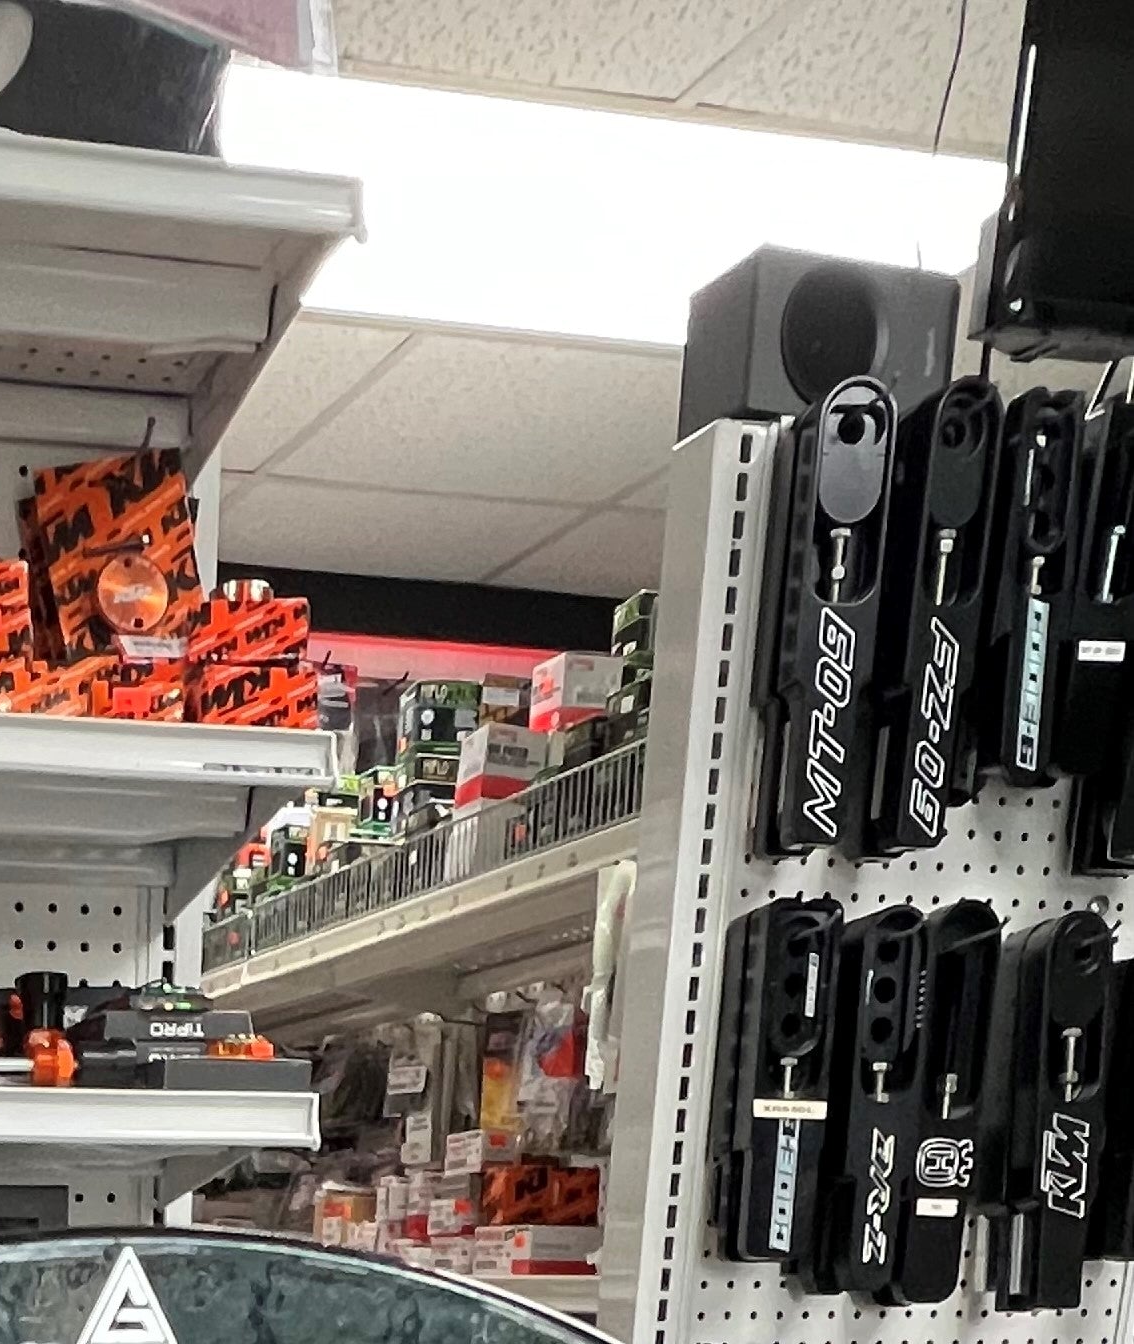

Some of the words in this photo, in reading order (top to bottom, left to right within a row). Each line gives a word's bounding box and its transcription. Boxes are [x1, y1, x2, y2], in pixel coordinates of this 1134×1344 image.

[803, 606, 856, 838] MT-09
[909, 616, 960, 839] FZ-09
[1040, 1112, 1091, 1220] KTM
